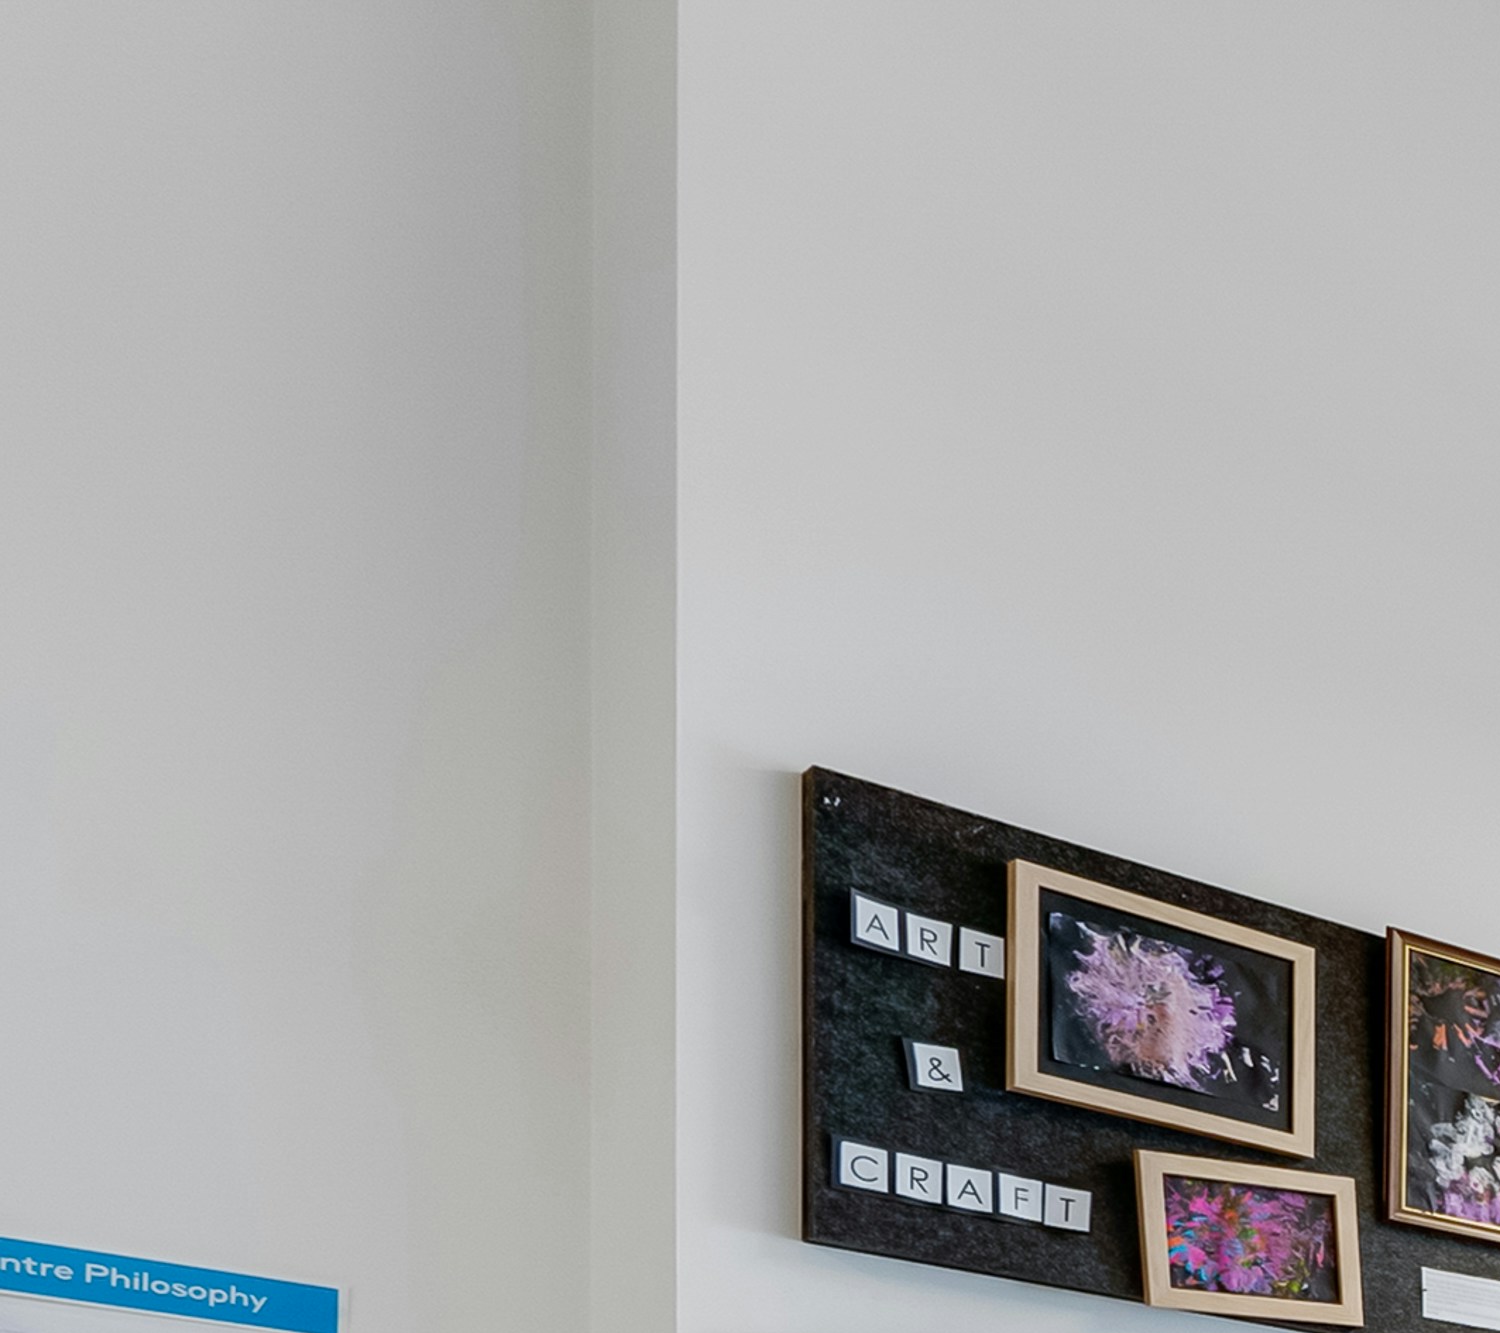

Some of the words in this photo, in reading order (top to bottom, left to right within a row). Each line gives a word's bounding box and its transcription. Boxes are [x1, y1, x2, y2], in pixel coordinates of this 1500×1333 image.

[864, 912, 992, 968] ART
[927, 1055, 952, 1084] &
[848, 1153, 1078, 1225] CRAFT
[85, 1262, 268, 1314] Philosophy
